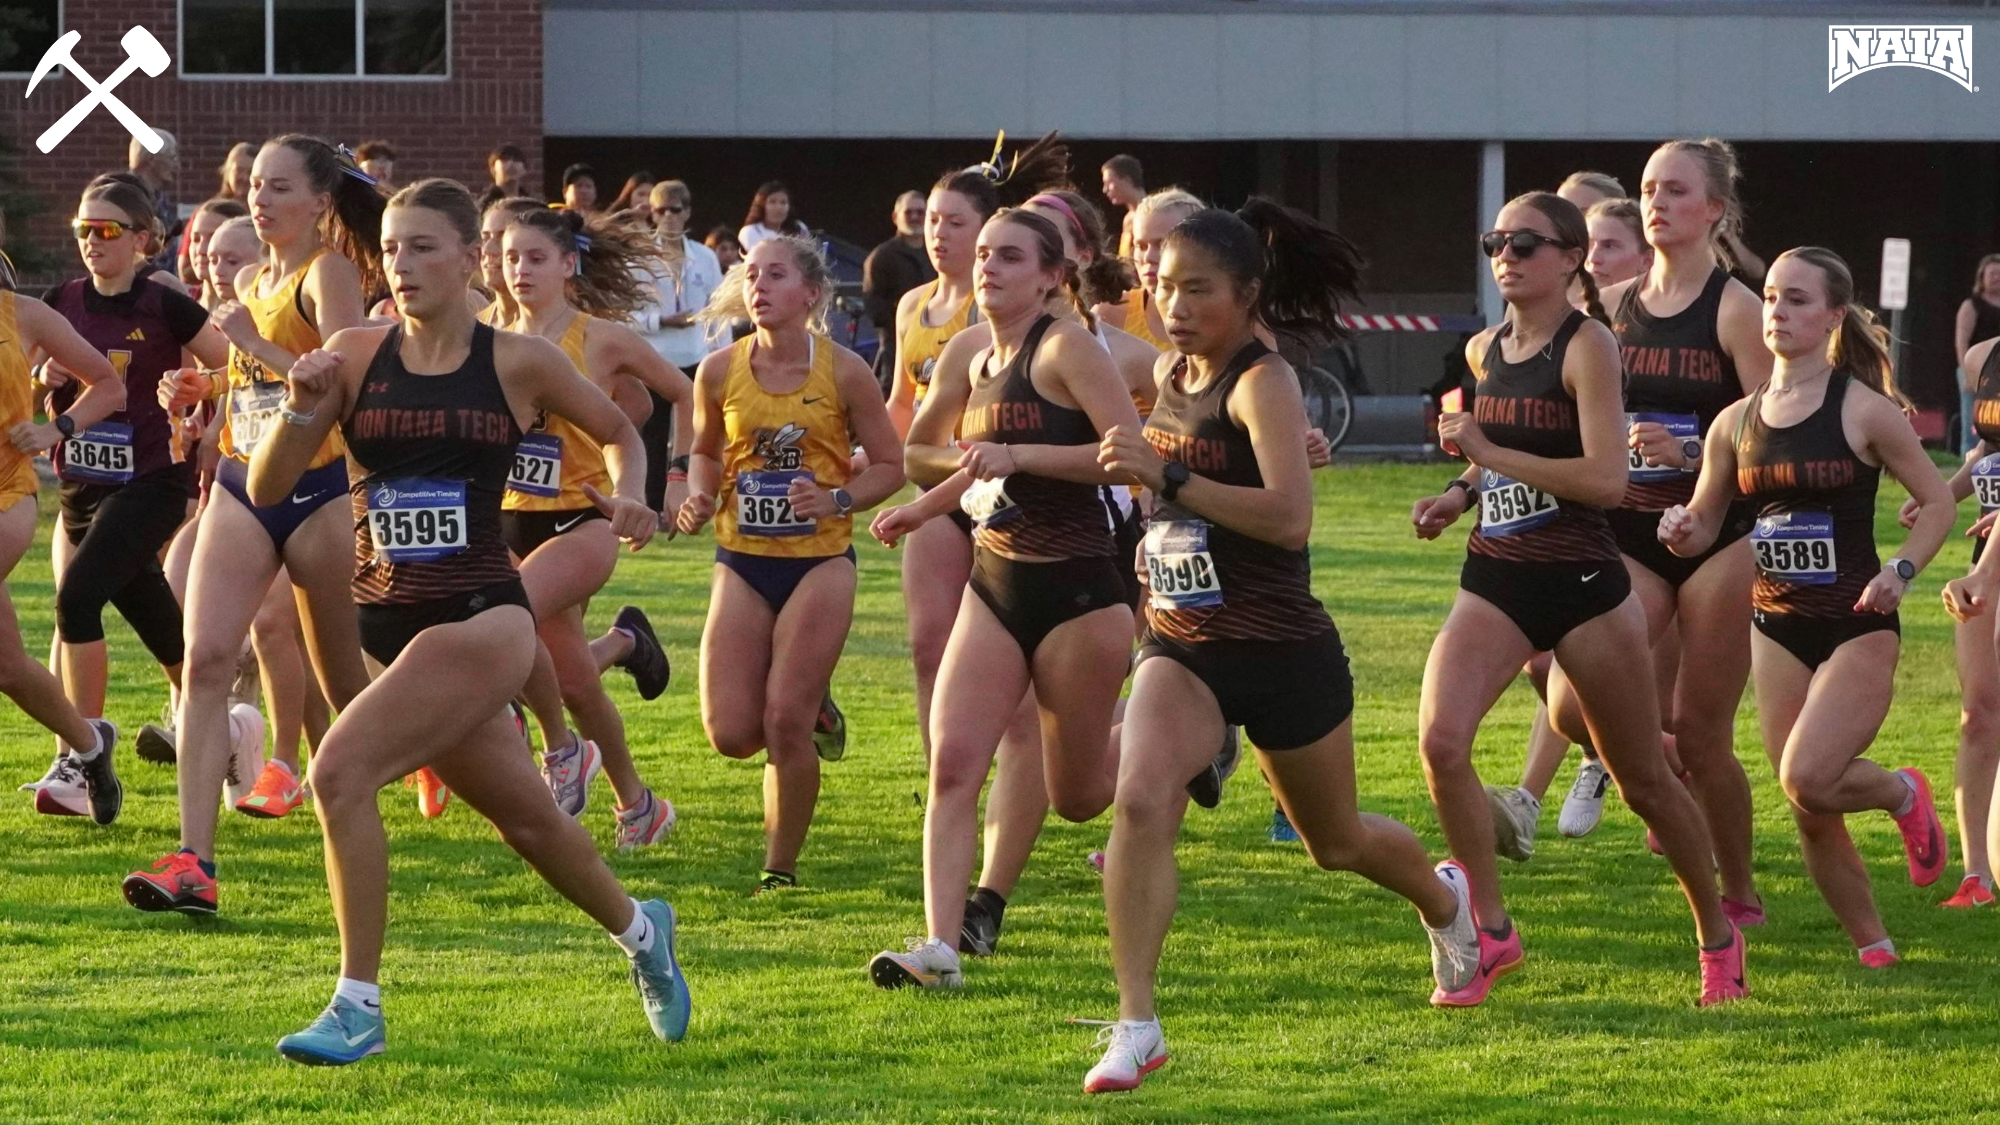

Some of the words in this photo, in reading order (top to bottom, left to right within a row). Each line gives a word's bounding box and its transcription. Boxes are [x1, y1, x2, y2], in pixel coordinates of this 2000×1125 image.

[1621, 345, 1670, 376] TANA
[1679, 347, 1722, 383] TECH
[457, 408, 510, 444] TECH
[991, 401, 1043, 431] TECH
[1523, 397, 1571, 430] TECH
[69, 440, 128, 470] 3645
[1179, 434, 1227, 470] TECH
[512, 455, 554, 485] 627
[1804, 459, 1854, 488] TECH
[398, 490, 436, 499] Competitive
[436, 490, 460, 498] Timing
[761, 482, 792, 490] Competitiv
[1976, 477, 2000, 504] 35
[743, 496, 810, 525] 362
[1487, 484, 1551, 523] 3592
[374, 509, 459, 547] 3595
[1756, 540, 1830, 571] 3589
[1150, 554, 1212, 593] 3590
